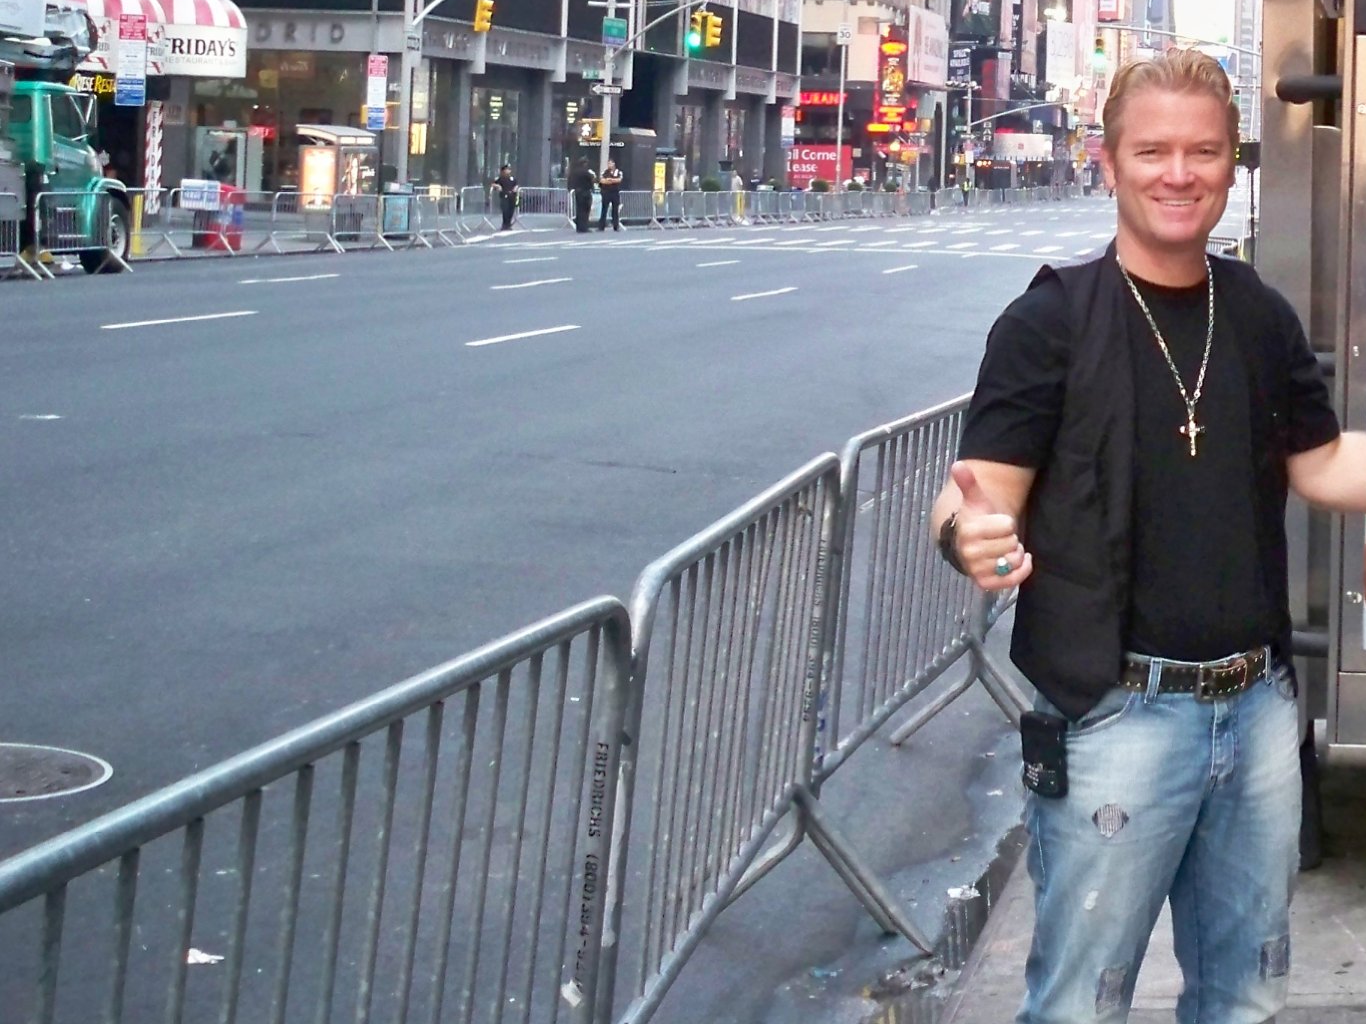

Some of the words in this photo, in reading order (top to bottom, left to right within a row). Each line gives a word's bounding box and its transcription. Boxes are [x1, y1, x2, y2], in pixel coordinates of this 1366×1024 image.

[840, 30, 851, 39] 30
[983, 121, 992, 142] BAR
[801, 149, 837, 161] Corne
[588, 741, 610, 839] FRIEDRICHS
